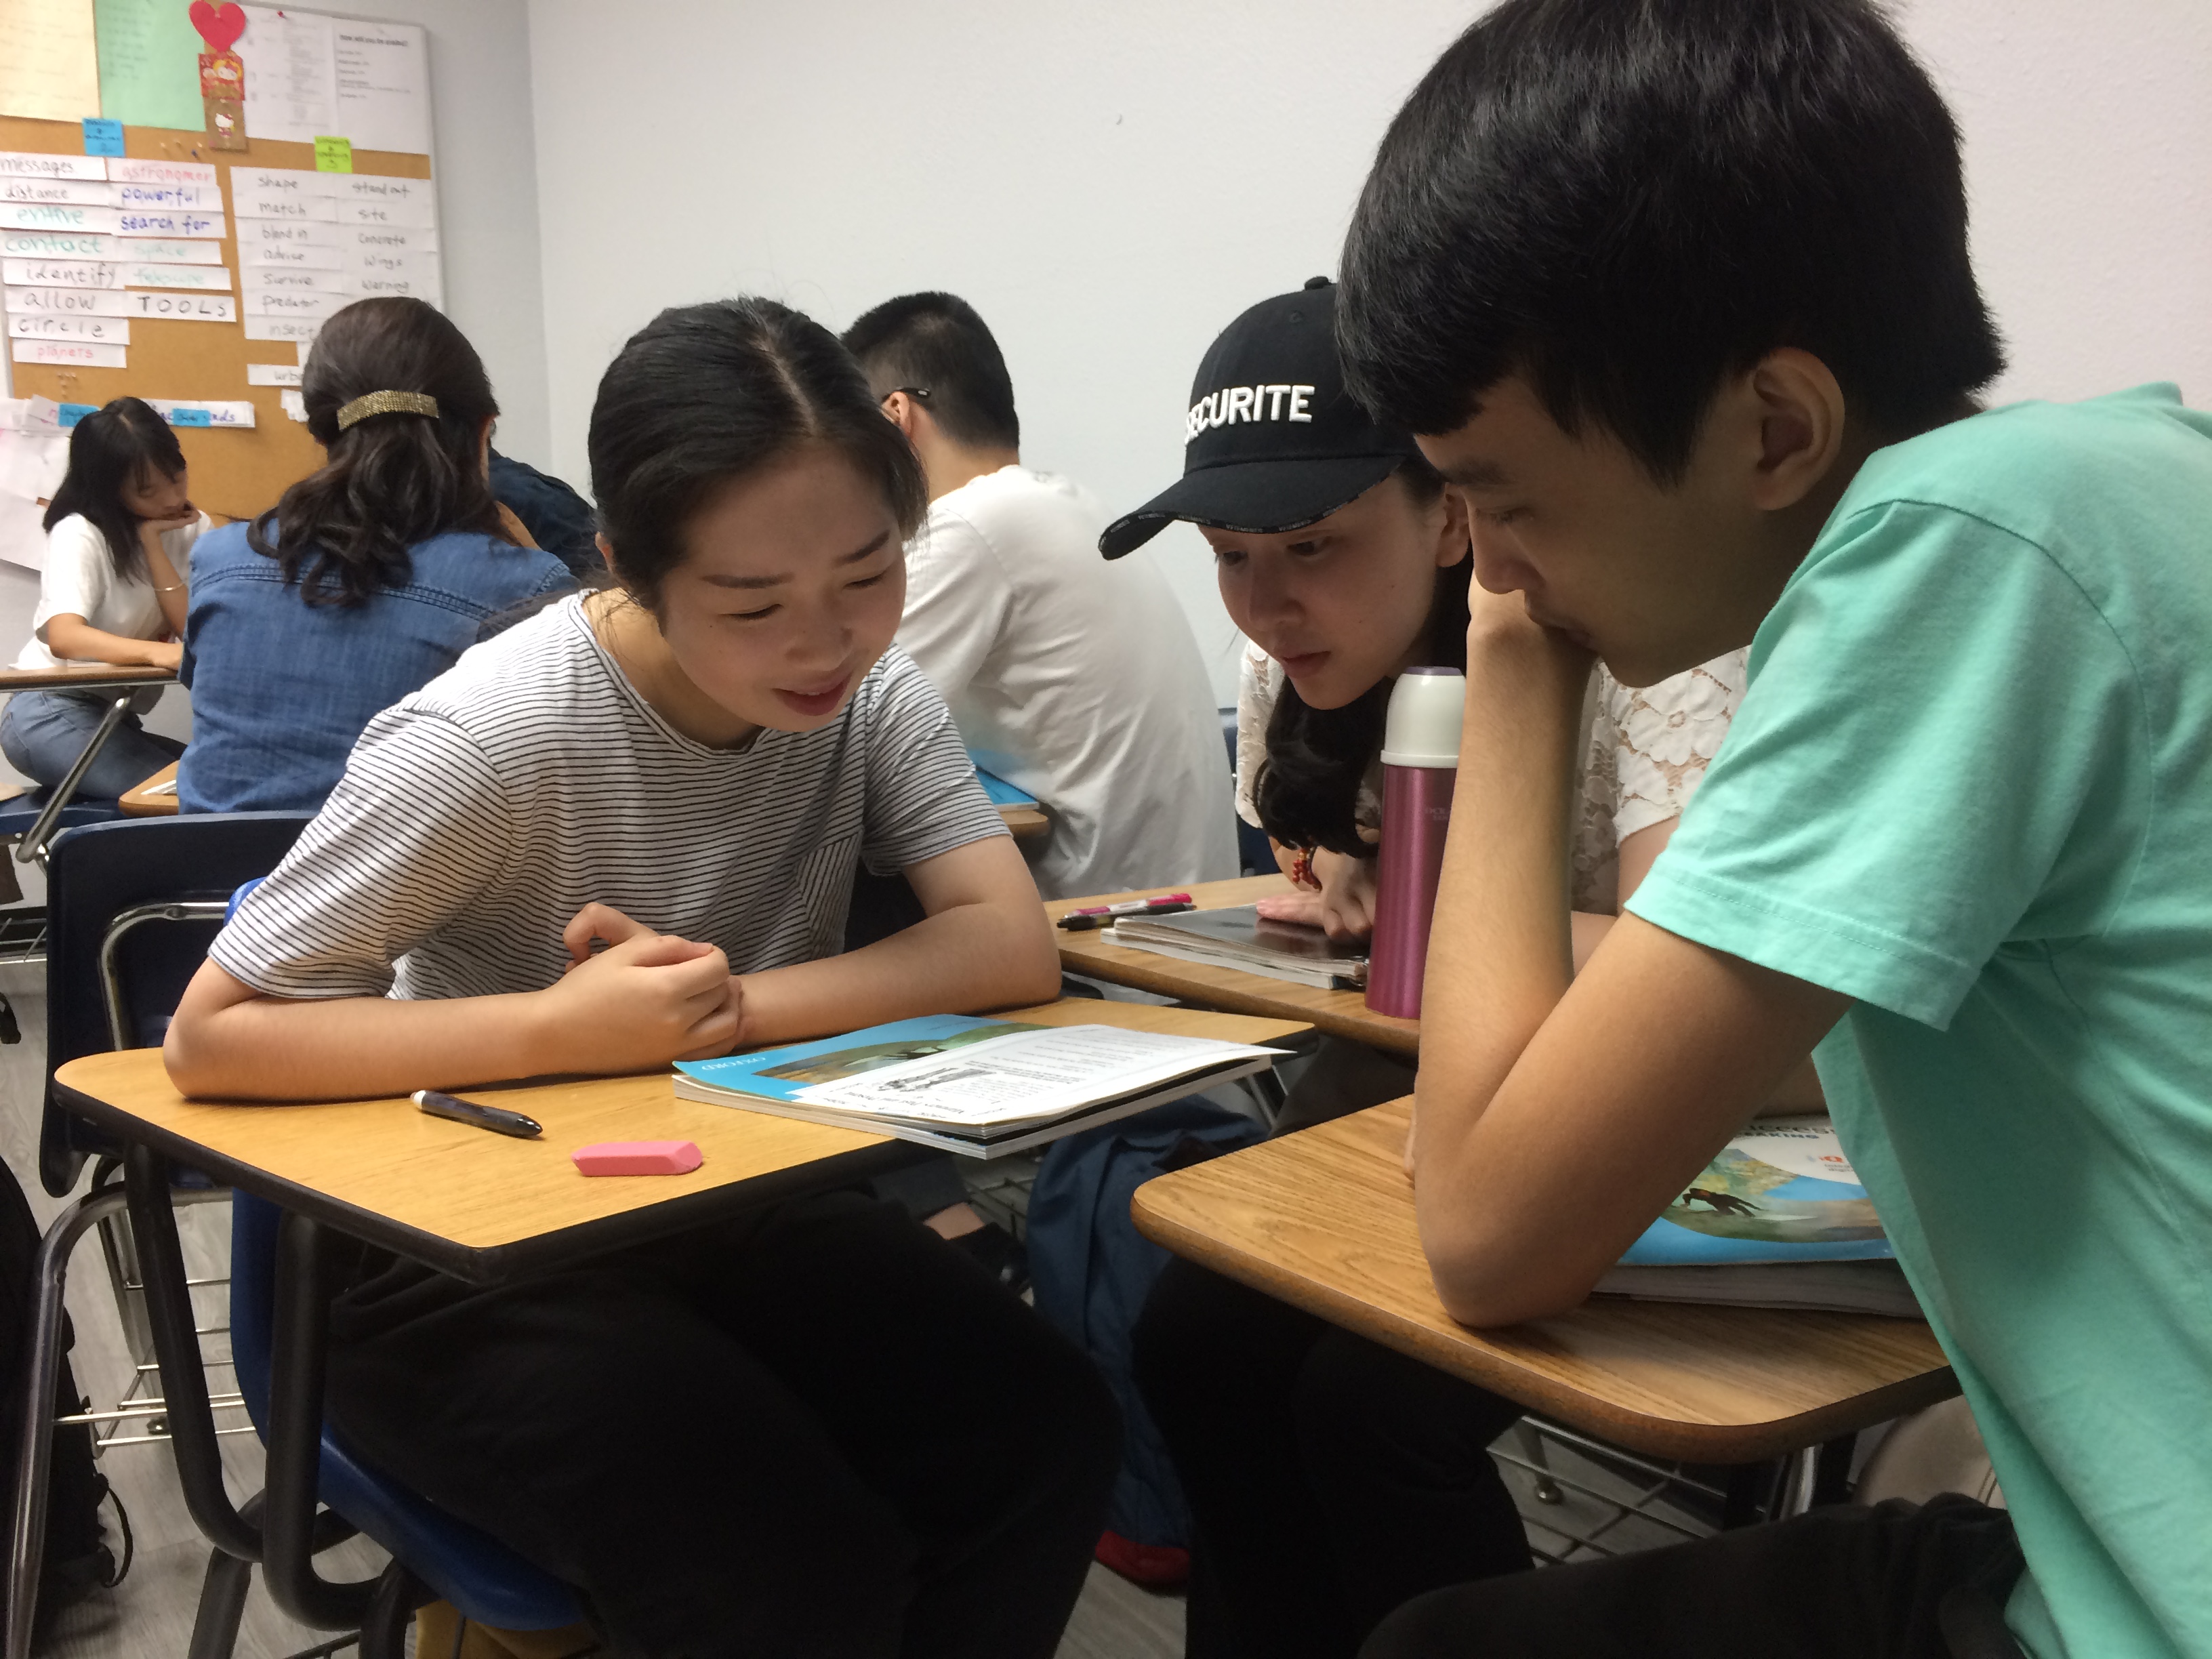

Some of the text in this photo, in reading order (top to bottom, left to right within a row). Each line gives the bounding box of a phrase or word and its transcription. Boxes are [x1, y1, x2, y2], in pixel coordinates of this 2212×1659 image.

[0, 158, 75, 178] messages
[122, 164, 212, 181] astronomer
[5, 184, 70, 199] distance
[121, 186, 201, 207] powerful
[121, 214, 211, 235] search for
[5, 234, 104, 253] contact
[26, 262, 116, 289] identify
[23, 290, 96, 311] allow
[136, 295, 227, 317] TOOLS
[18, 317, 105, 337] circle
[37, 344, 94, 361] planets
[701, 1057, 766, 1070] OXFORD
